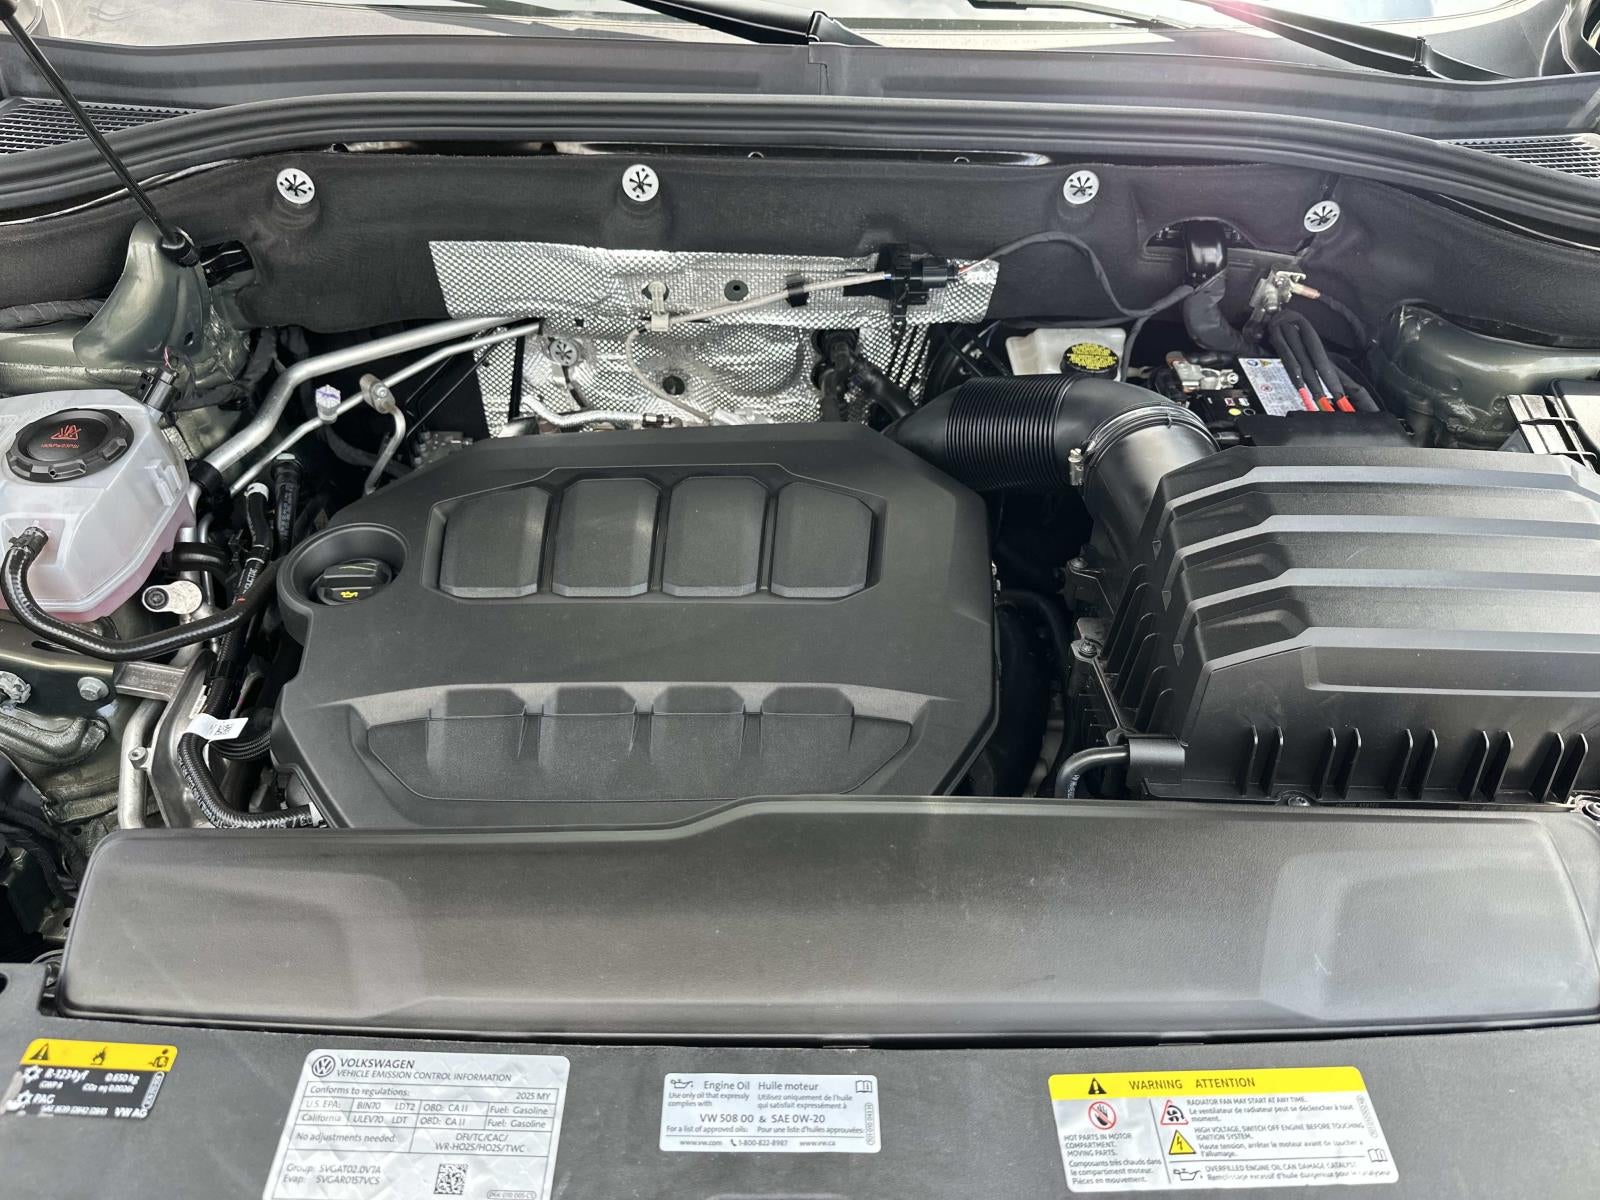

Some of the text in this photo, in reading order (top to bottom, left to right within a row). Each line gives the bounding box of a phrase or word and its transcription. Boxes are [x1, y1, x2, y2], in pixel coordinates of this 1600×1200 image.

[340, 1058, 415, 1069] VOLKSWAGEN
[44, 1068, 90, 1083] R-1234yf
[336, 1070, 512, 1082] VEHICLE EMISSION CONTROL INFORMATION
[704, 1081, 750, 1092] Engine Oil
[758, 1081, 819, 1091] Huile moteur
[1128, 1077, 1256, 1090] WARNING ATTENTION
[310, 1086, 410, 1097] Conforms to regulations:
[516, 1092, 550, 1100] 2025 MY
[32, 1094, 56, 1104] PAG
[356, 1102, 416, 1111] BIN70 LDT2
[424, 1104, 444, 1112] OBD:
[448, 1104, 461, 1112] CA
[490, 1105, 548, 1115] Fuel: Gasoline
[114, 1107, 132, 1118] VW
[131, 1108, 148, 1118] AG
[353, 1115, 408, 1124] ULEV70 LDT
[420, 1117, 442, 1126] OBD:
[445, 1118, 458, 1126] CA
[700, 1113, 826, 1123] VW 508 00 & SAE 0W-20
[488, 1119, 546, 1129] Fuel: Gasoline
[297, 1132, 309, 1140] No
[310, 1132, 362, 1144] adjustments
